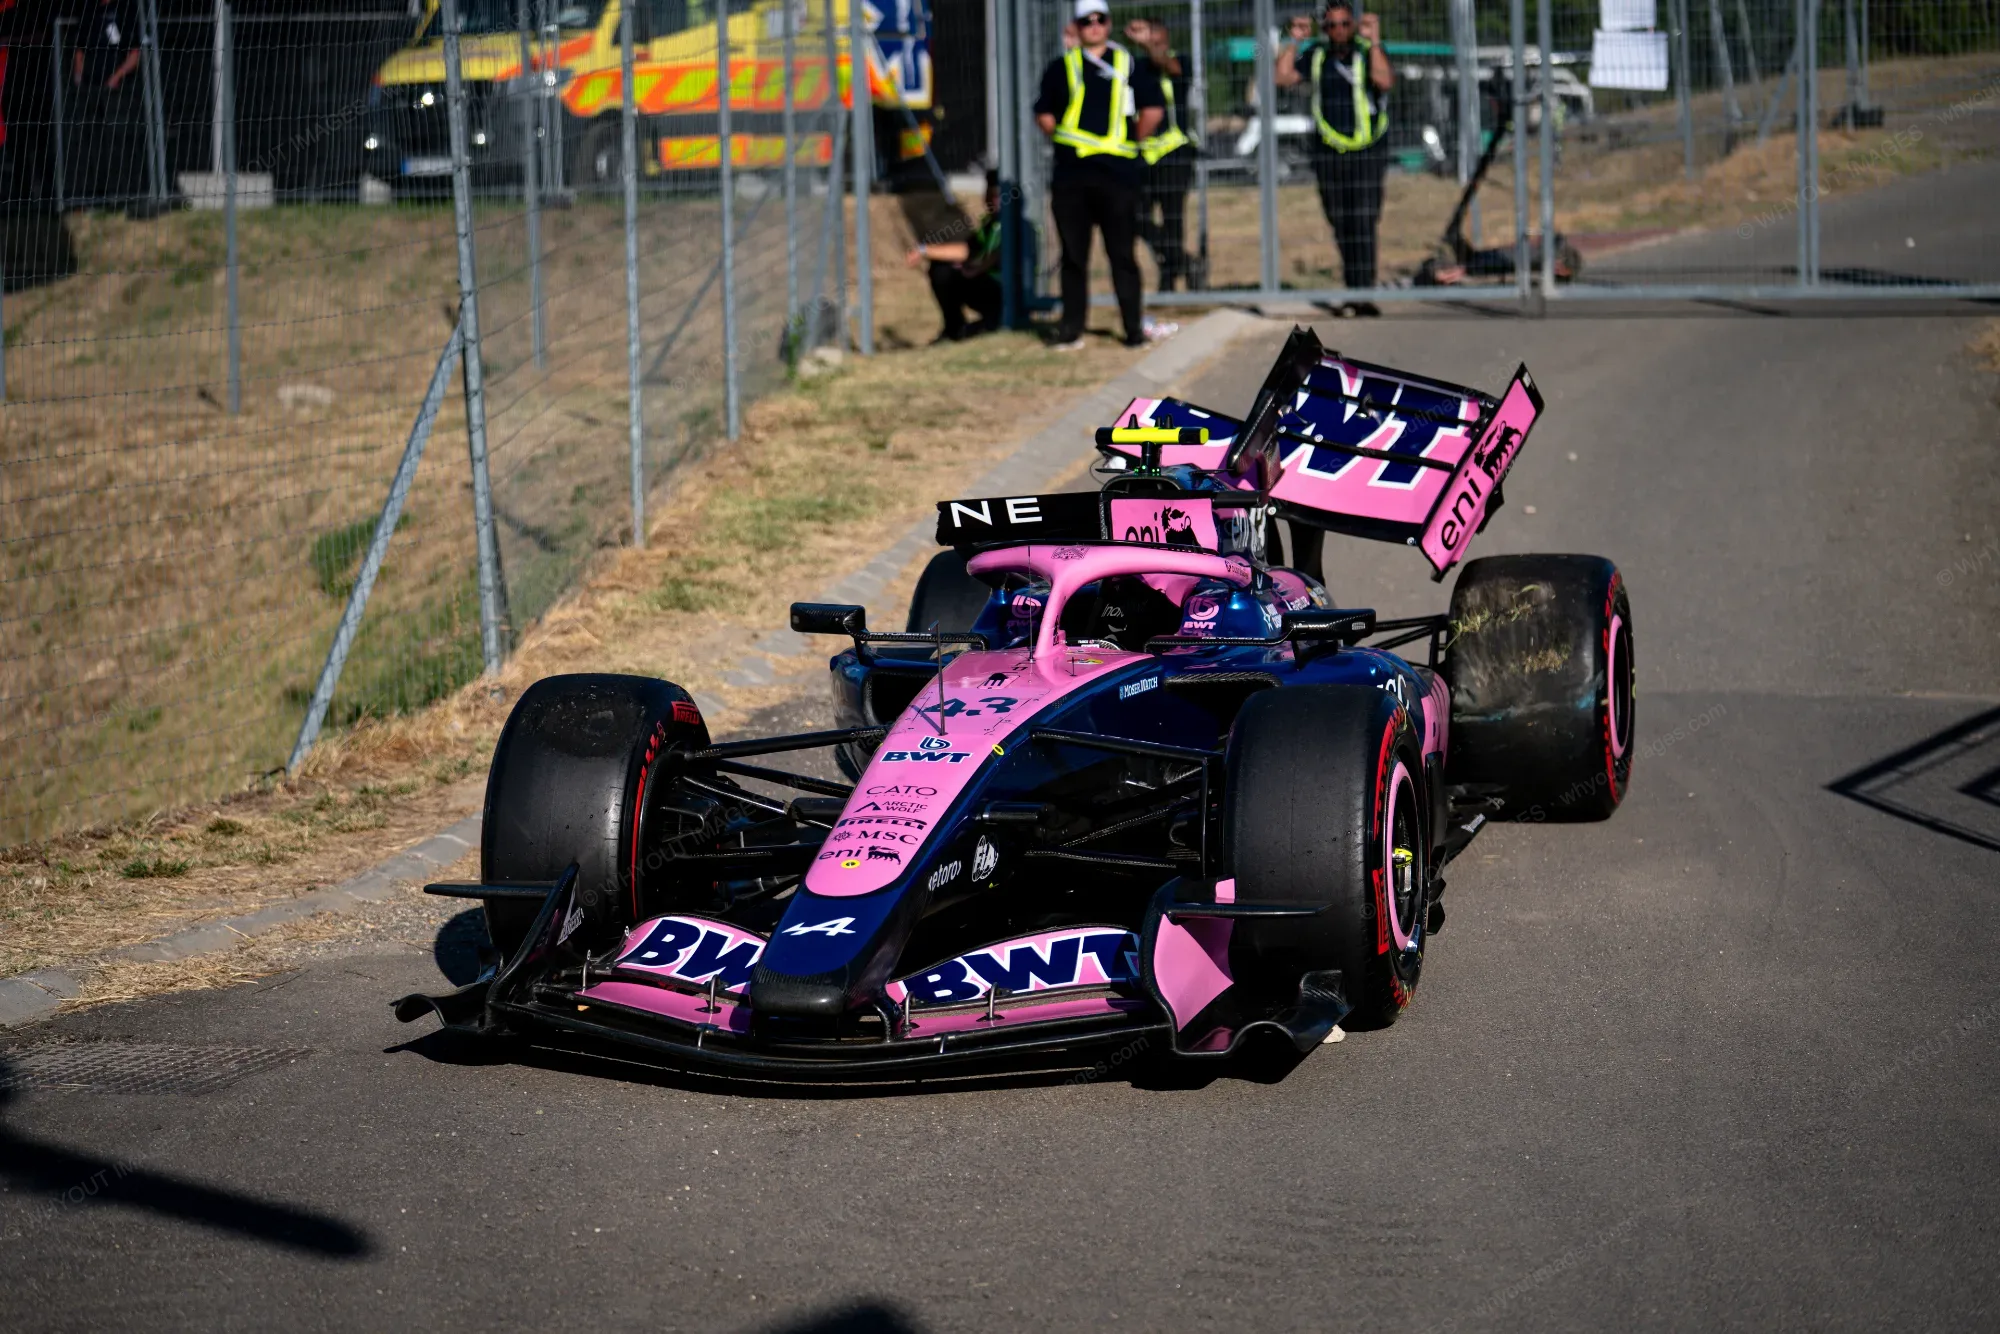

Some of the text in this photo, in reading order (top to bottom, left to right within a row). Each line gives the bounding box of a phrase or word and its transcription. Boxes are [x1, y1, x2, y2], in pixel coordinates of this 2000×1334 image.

[1441, 469, 1482, 551] eni
[1183, 621, 1216, 630] BWT
[880, 751, 973, 764] BWT
[866, 785, 938, 797] CATO
[882, 800, 929, 810] ARCTIC
[886, 805, 922, 814] WOLF
[837, 814, 928, 831] PIRELLI
[855, 830, 919, 845] MSC
[818, 845, 864, 860] eni
[899, 931, 1141, 1003] BWT
